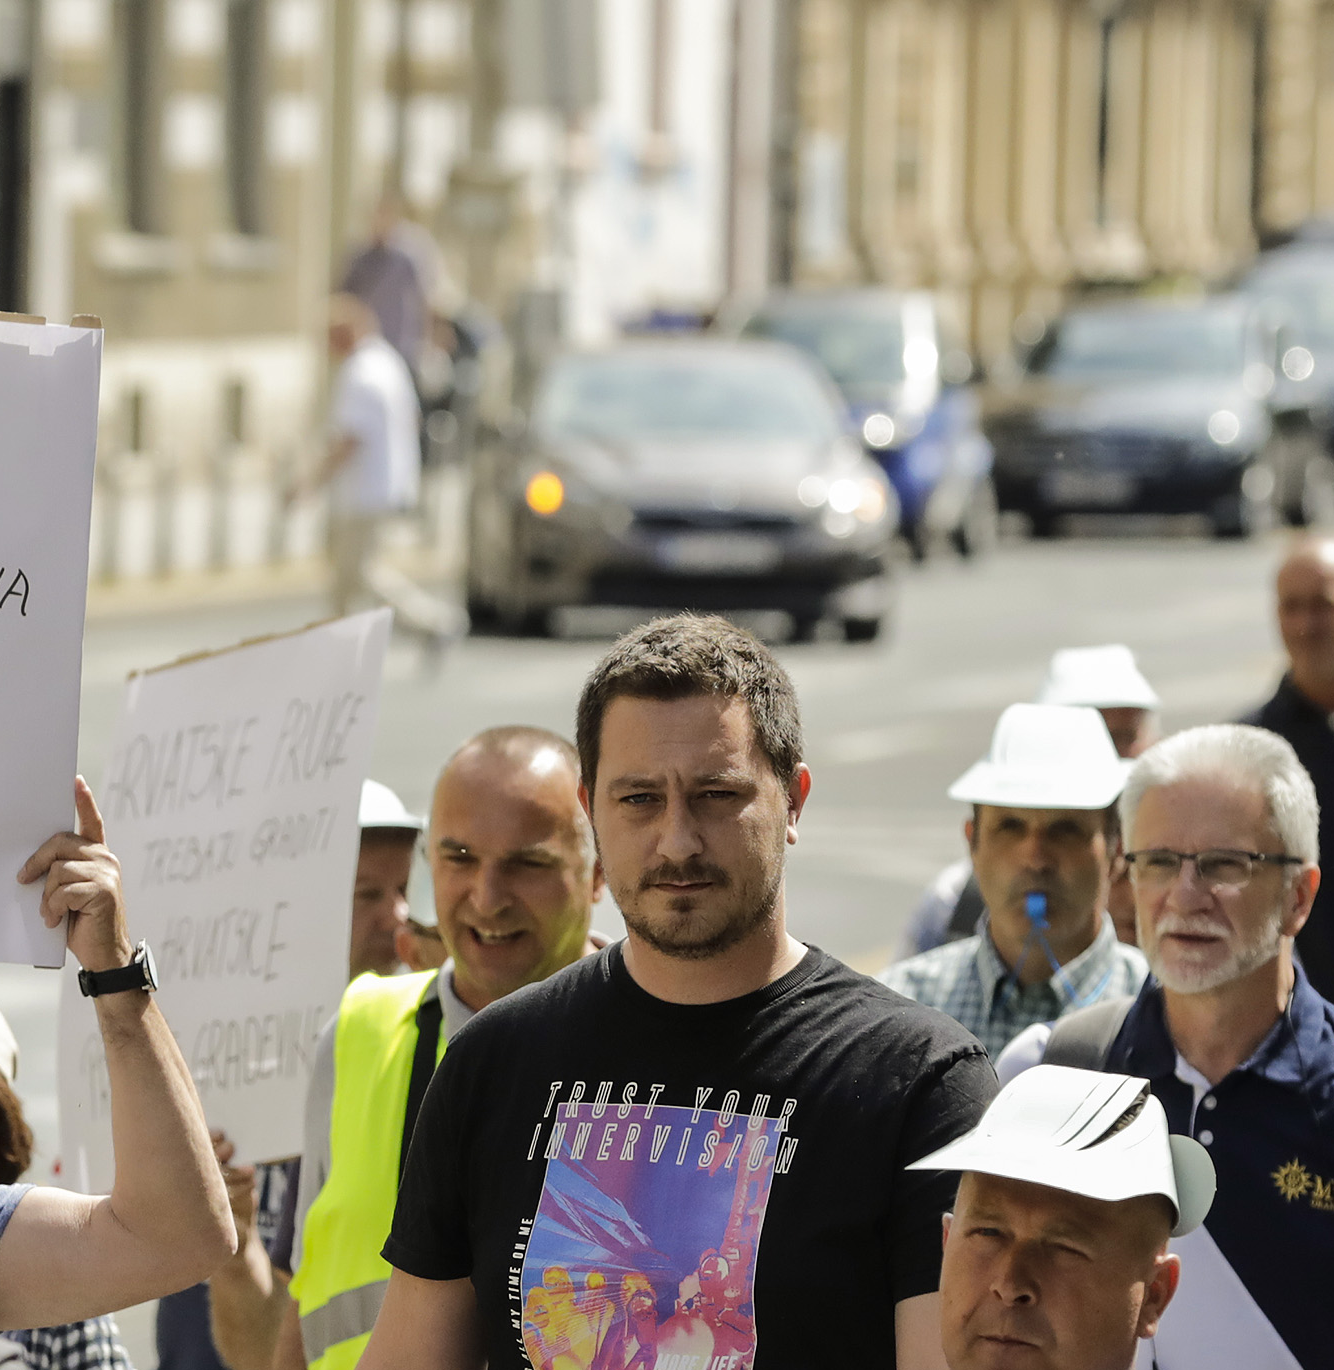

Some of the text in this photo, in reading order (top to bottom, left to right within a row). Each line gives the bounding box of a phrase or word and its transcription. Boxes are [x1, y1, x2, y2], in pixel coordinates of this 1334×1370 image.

[544, 1081, 798, 1133] TRUST YOUR
[527, 1122, 799, 1175] INNERVISION
[518, 1217, 534, 1237] ME
[512, 1243, 527, 1260] ON
[508, 1266, 521, 1301] TIME
[511, 1308, 521, 1330] MY
[515, 1337, 531, 1361] ALL
